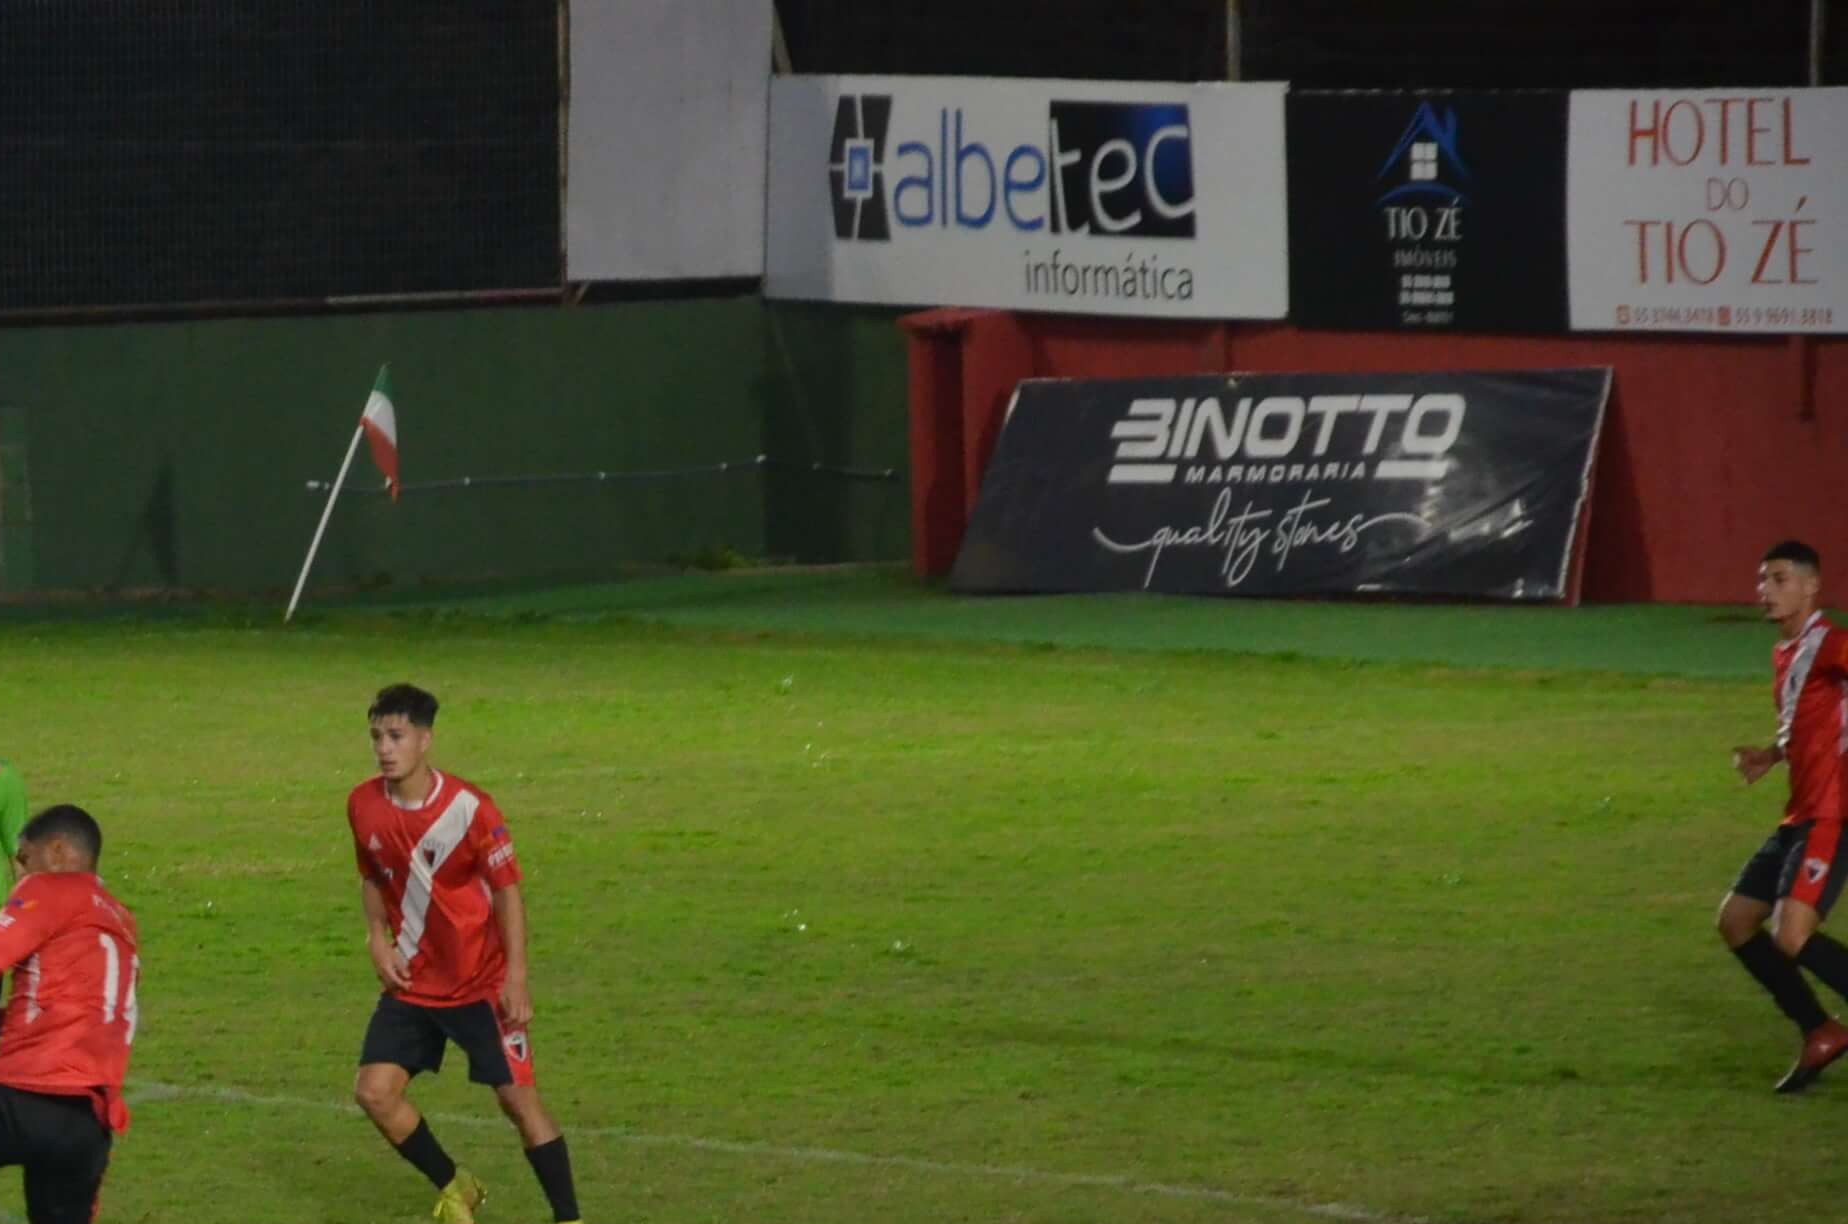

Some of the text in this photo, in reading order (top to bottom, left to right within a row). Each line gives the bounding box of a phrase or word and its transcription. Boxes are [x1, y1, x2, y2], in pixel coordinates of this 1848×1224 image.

[1627, 97, 1811, 166] HOTEL
[892, 108, 1195, 233] albetec
[1705, 177, 1749, 212] DO
[1384, 196, 1463, 240] TIO ZÉ
[1623, 197, 1819, 286] TIO ZÉ
[1025, 250, 1194, 300] informática
[1109, 393, 1466, 460] BINOTTO
[1184, 461, 1367, 484] MARMORARIA
[1137, 486, 1377, 588] quality stones
